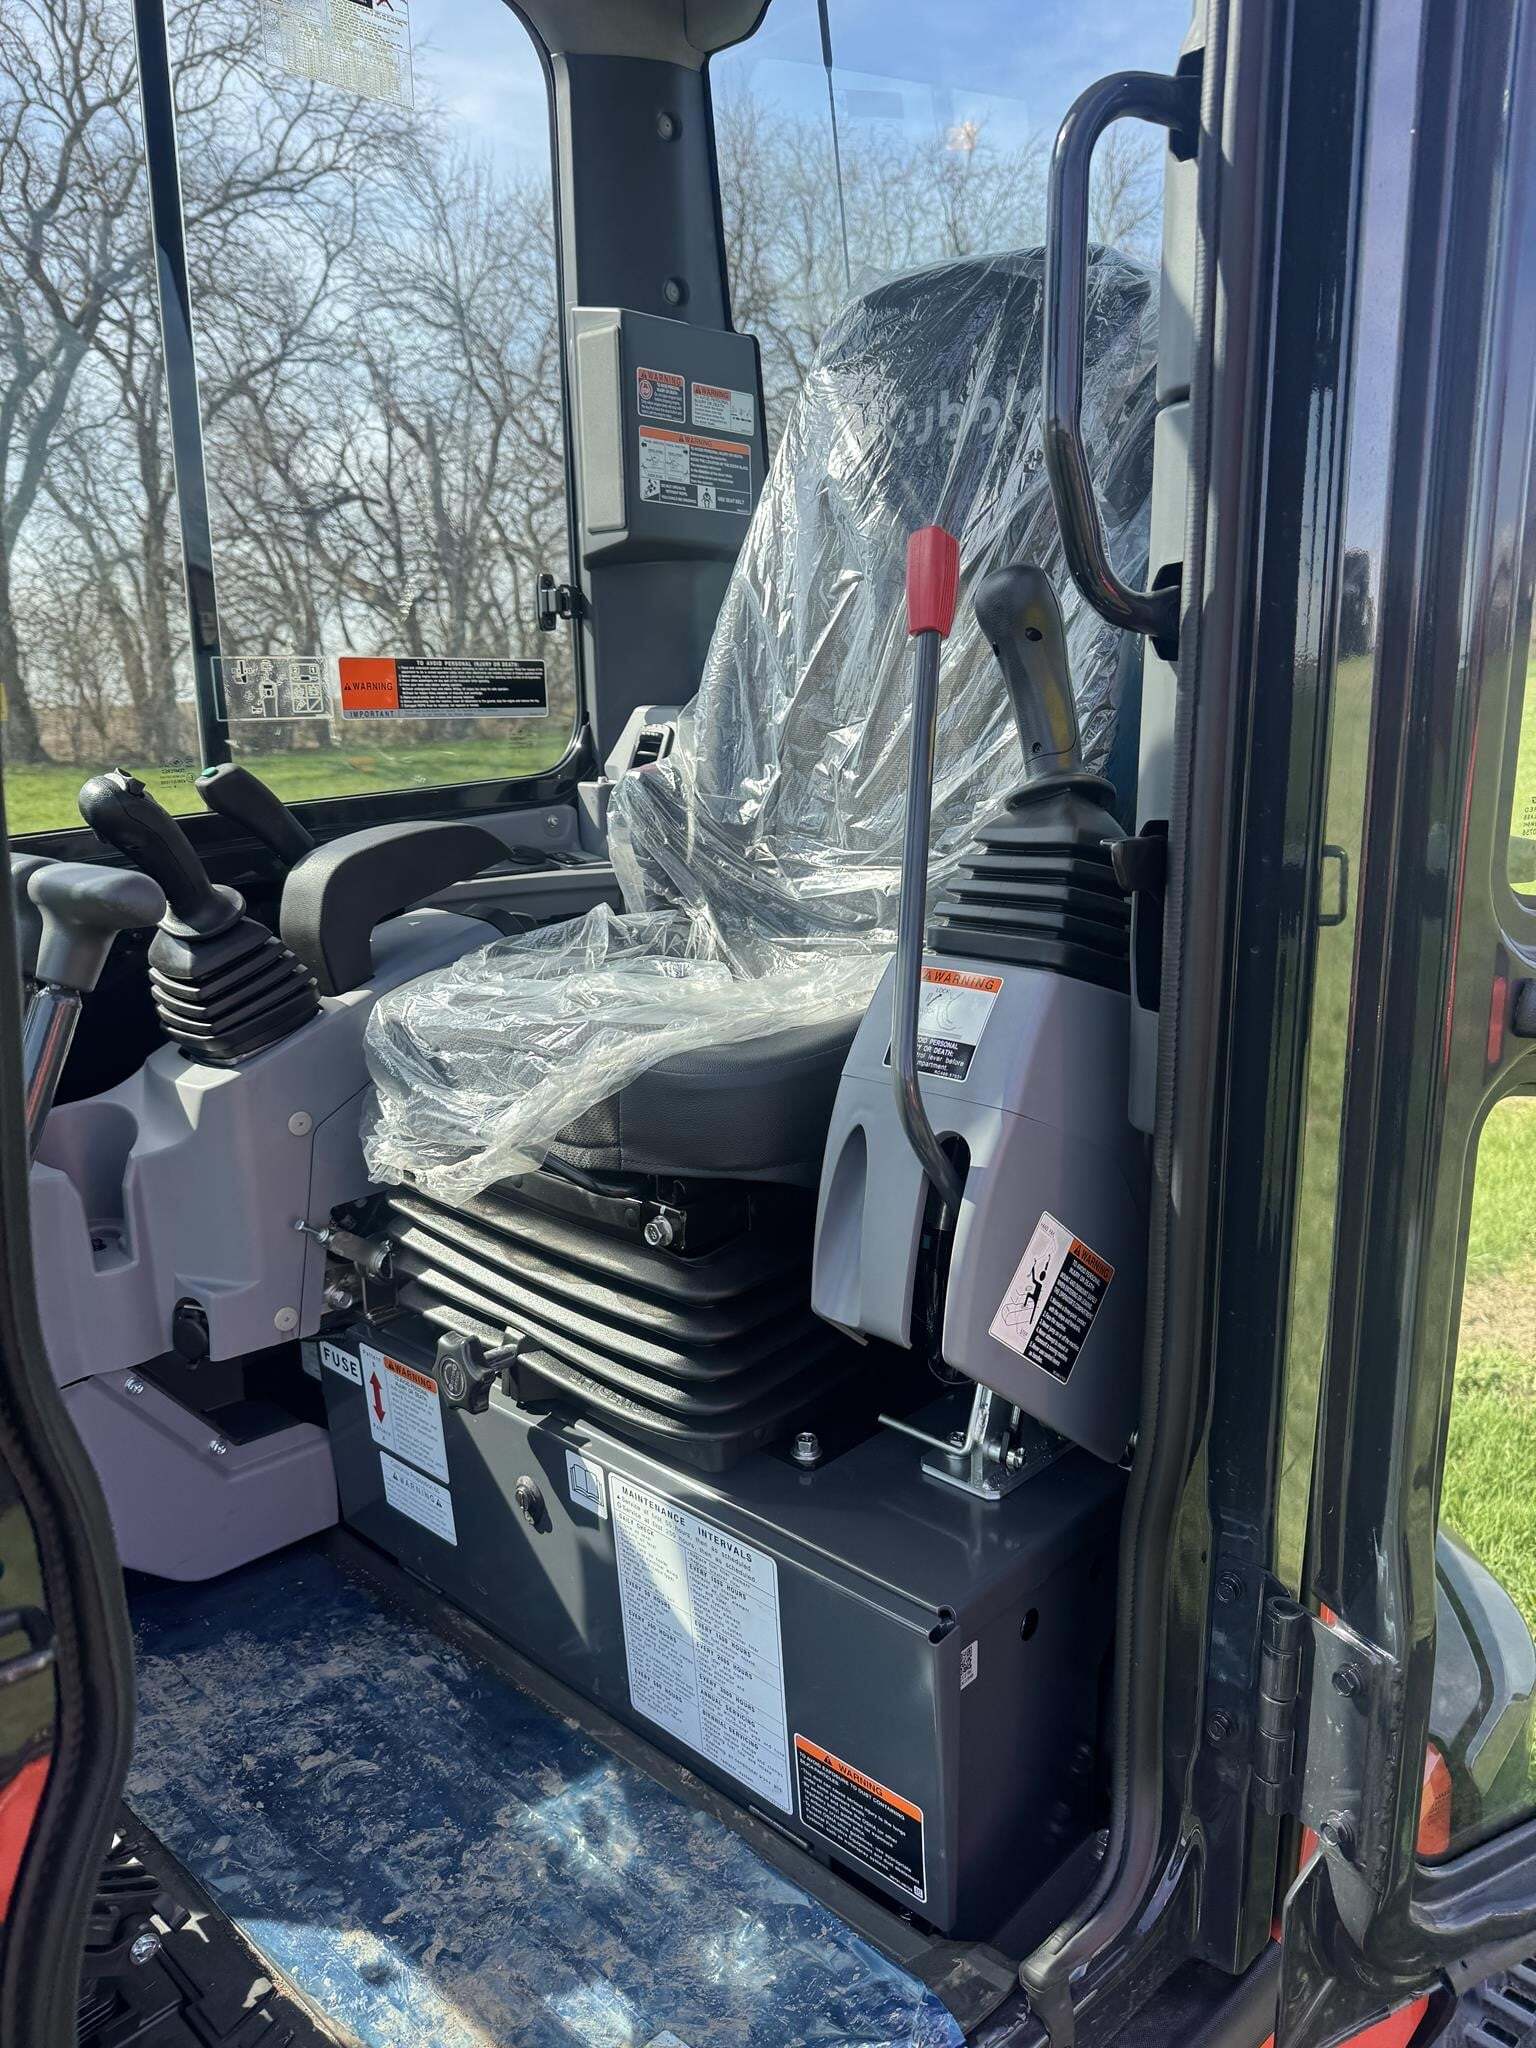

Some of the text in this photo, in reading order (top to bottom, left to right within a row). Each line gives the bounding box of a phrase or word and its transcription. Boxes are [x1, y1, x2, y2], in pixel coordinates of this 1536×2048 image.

[353, 682, 393, 691] WARNING
[350, 710, 394, 718] IMPORTANT
[934, 968, 995, 991] WARNING
[930, 1039, 959, 1050] PERSONAL
[1079, 1248, 1110, 1278] WARNING
[323, 1346, 359, 1378] FUSE
[394, 1364, 433, 1390] WARNING
[399, 1475, 434, 1503] WARNING
[622, 1485, 685, 1527] MAINTENANCE
[697, 1525, 752, 1563] INTERVALS
[625, 1577, 641, 1593] EVERY
[653, 1594, 670, 1610] HOURS
[689, 1563, 707, 1579] EVERY
[726, 1583, 746, 1600] HOURS
[628, 1608, 644, 1624] EVERY
[658, 1627, 676, 1644] HOURS
[694, 1619, 712, 1635] EVERY
[731, 1641, 751, 1658] HOURS
[696, 1641, 713, 1657] EVERY
[733, 1663, 752, 1680] HOURS
[634, 1666, 650, 1682] EVERY
[664, 1686, 682, 1704] HOURS
[699, 1672, 716, 1689] EVERY
[735, 1695, 755, 1713] HOURS
[700, 1687, 722, 1707] ANNUAL
[725, 1703, 755, 1728] SERVICING
[702, 1708, 758, 1750] BIENNIAL SERVICING
[838, 1762, 882, 1797] WARNING
